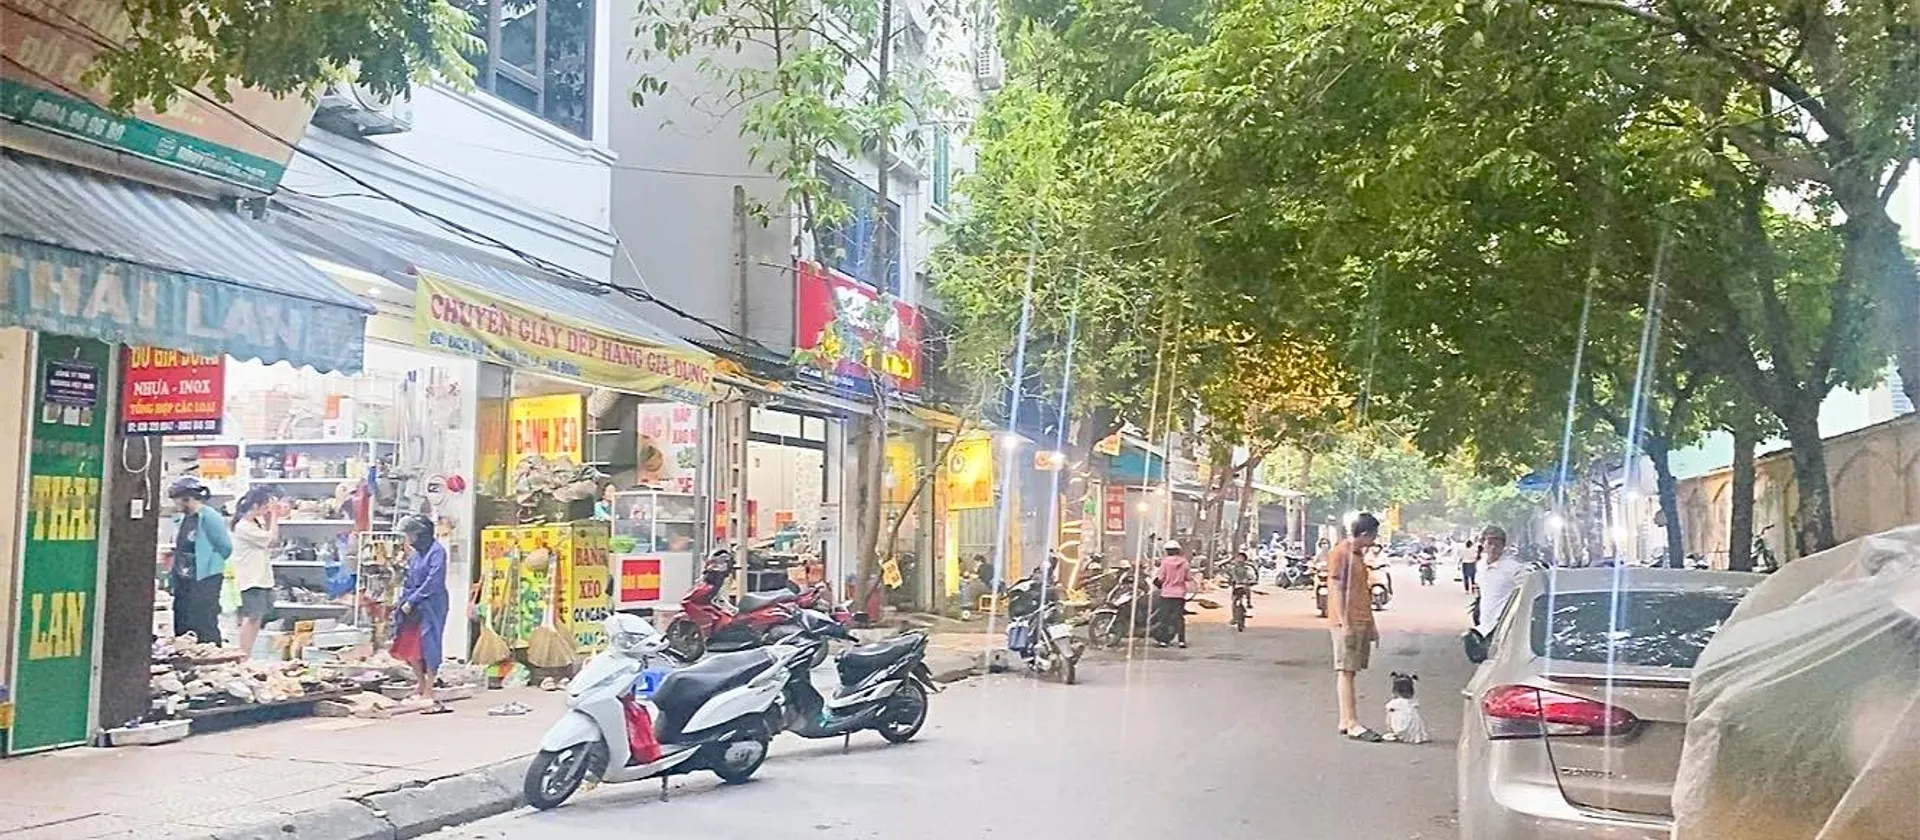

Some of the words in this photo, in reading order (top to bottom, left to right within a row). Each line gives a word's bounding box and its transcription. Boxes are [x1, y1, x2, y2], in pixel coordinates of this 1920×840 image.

[186, 287, 312, 352] LAN
[430, 293, 512, 337] CHUYÊN
[133, 379, 169, 399] NHỰA
[179, 379, 211, 394] INOX
[32, 461, 99, 541] THÁI
[28, 591, 86, 660] LAN
